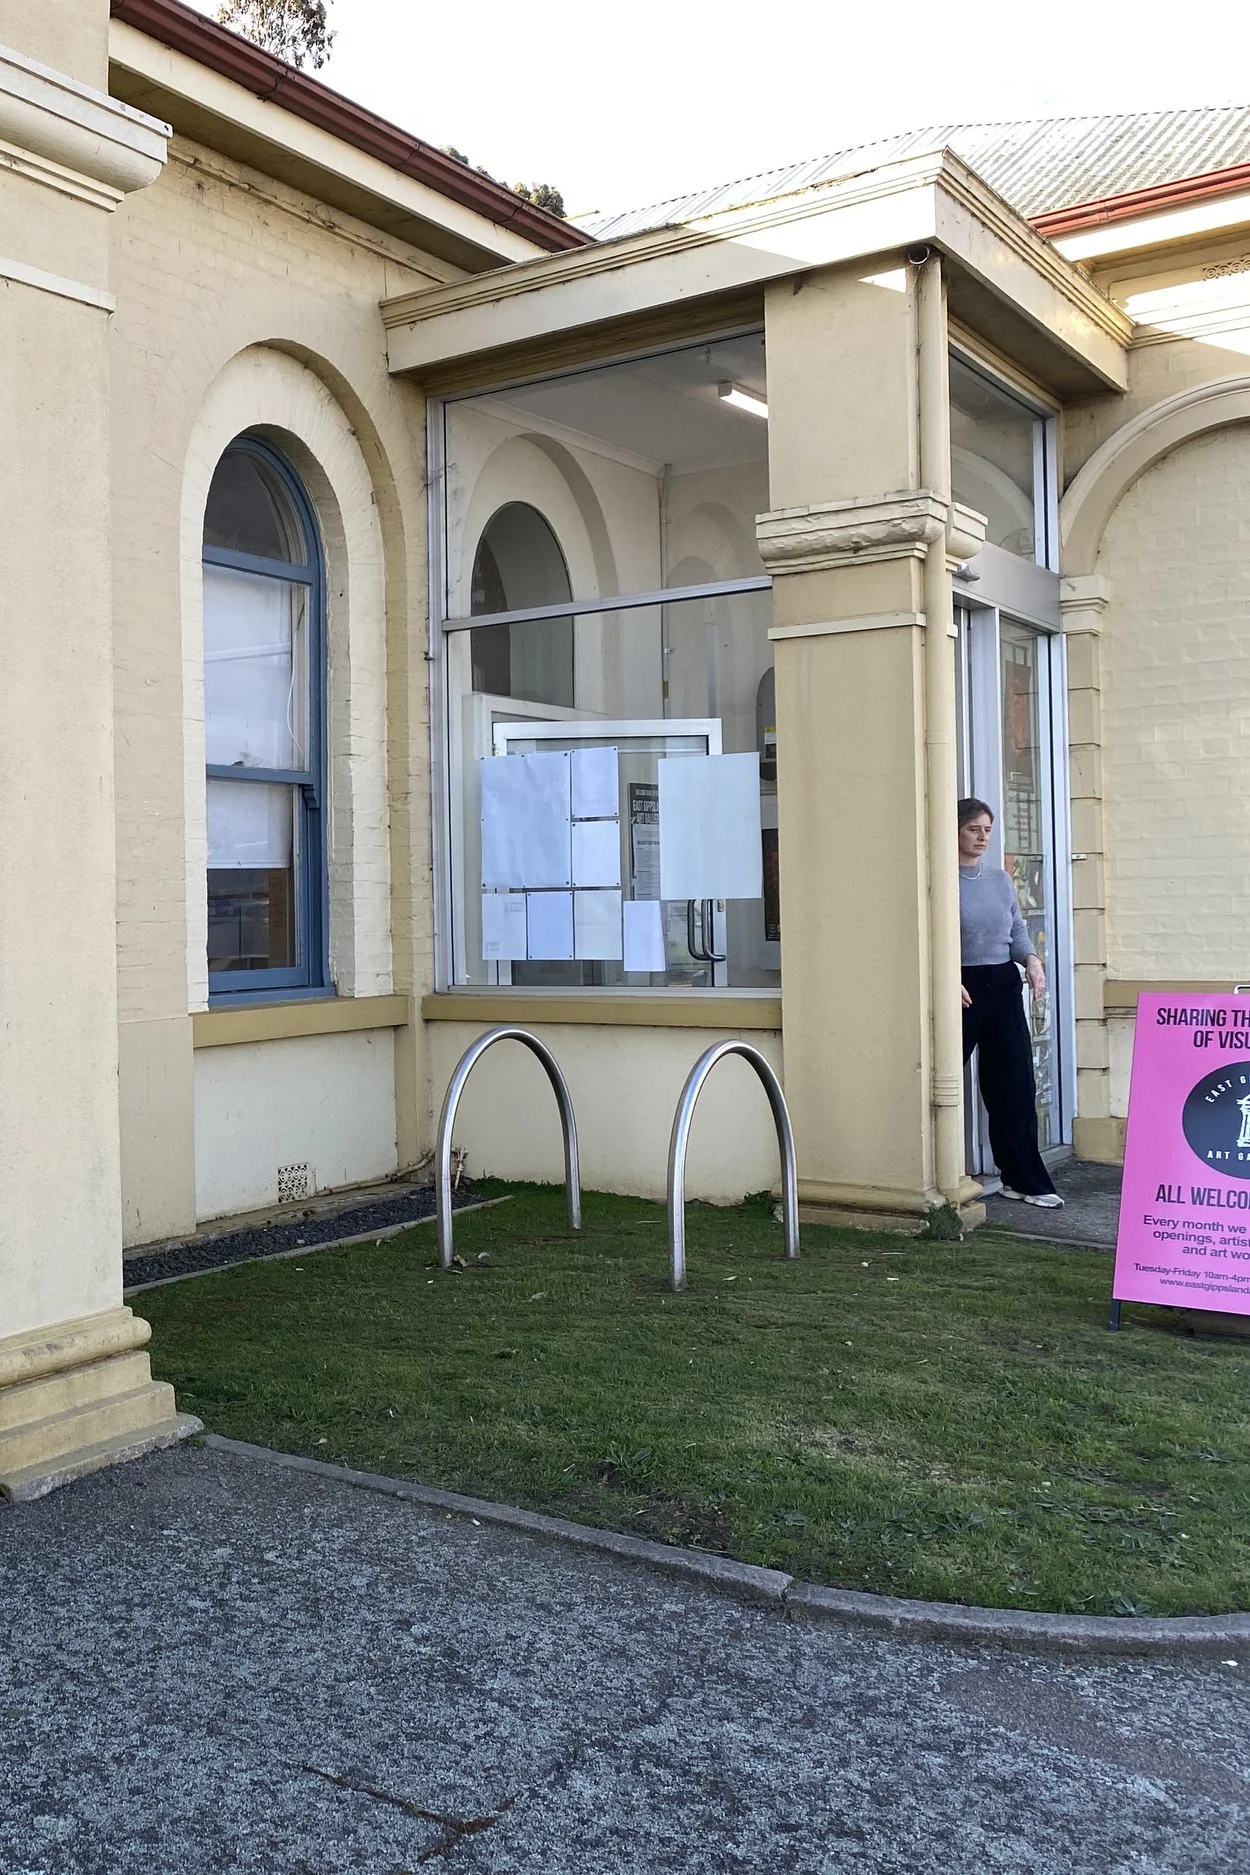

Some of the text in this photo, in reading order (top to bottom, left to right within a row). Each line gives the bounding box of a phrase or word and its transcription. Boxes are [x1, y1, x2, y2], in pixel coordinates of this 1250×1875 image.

[1156, 1007, 1227, 1027] SHARING
[1193, 1030, 1214, 1048] OF
[1205, 1079, 1232, 1103] EAST
[1207, 1150, 1230, 1160] ART
[1155, 1184, 1250, 1210] ALL WELCO
[1143, 1215, 1247, 1234] Every month we
[1153, 1230, 1216, 1245] openings,
[1182, 1246, 1207, 1256] and
[1210, 1248, 1228, 1258] art
[1134, 1262, 1202, 1279] Tuesday-Friday
